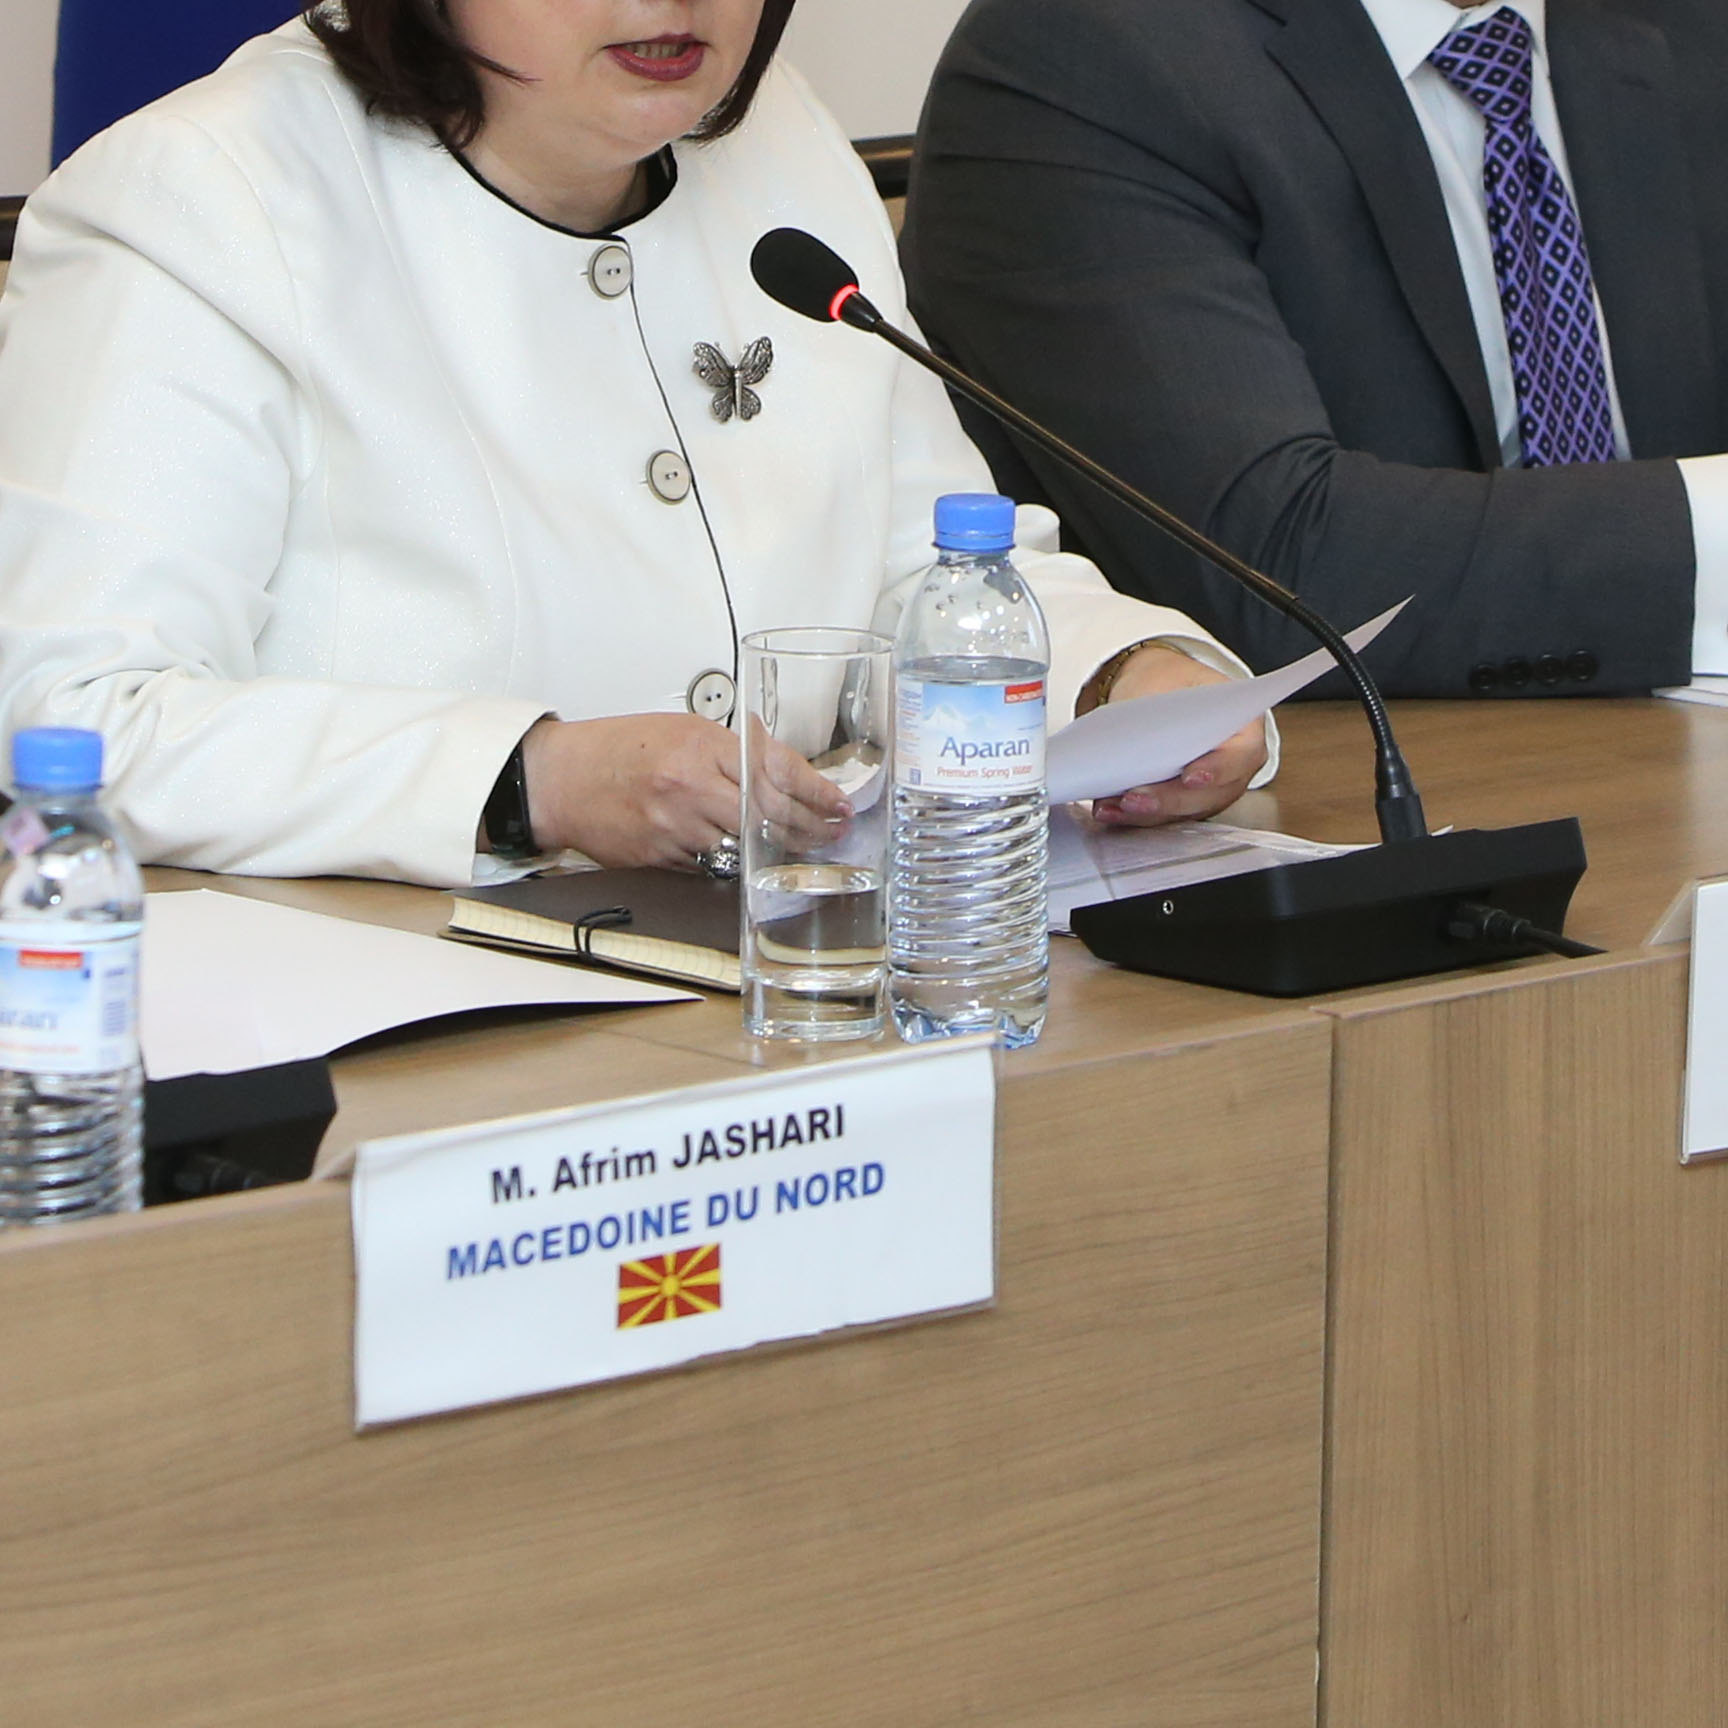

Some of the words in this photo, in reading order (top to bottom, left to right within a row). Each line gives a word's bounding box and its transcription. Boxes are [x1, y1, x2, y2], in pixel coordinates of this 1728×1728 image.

[936, 766, 978, 778] Premium
[981, 766, 1010, 780] Spring
[939, 735, 1031, 767] Aparan
[491, 1165, 536, 1204] M.
[552, 1147, 657, 1193] Afrim
[672, 1104, 846, 1169] JASHARI
[447, 1200, 691, 1281] MACEDOINE
[707, 1185, 759, 1228] DU
[775, 1161, 886, 1214] NORD
